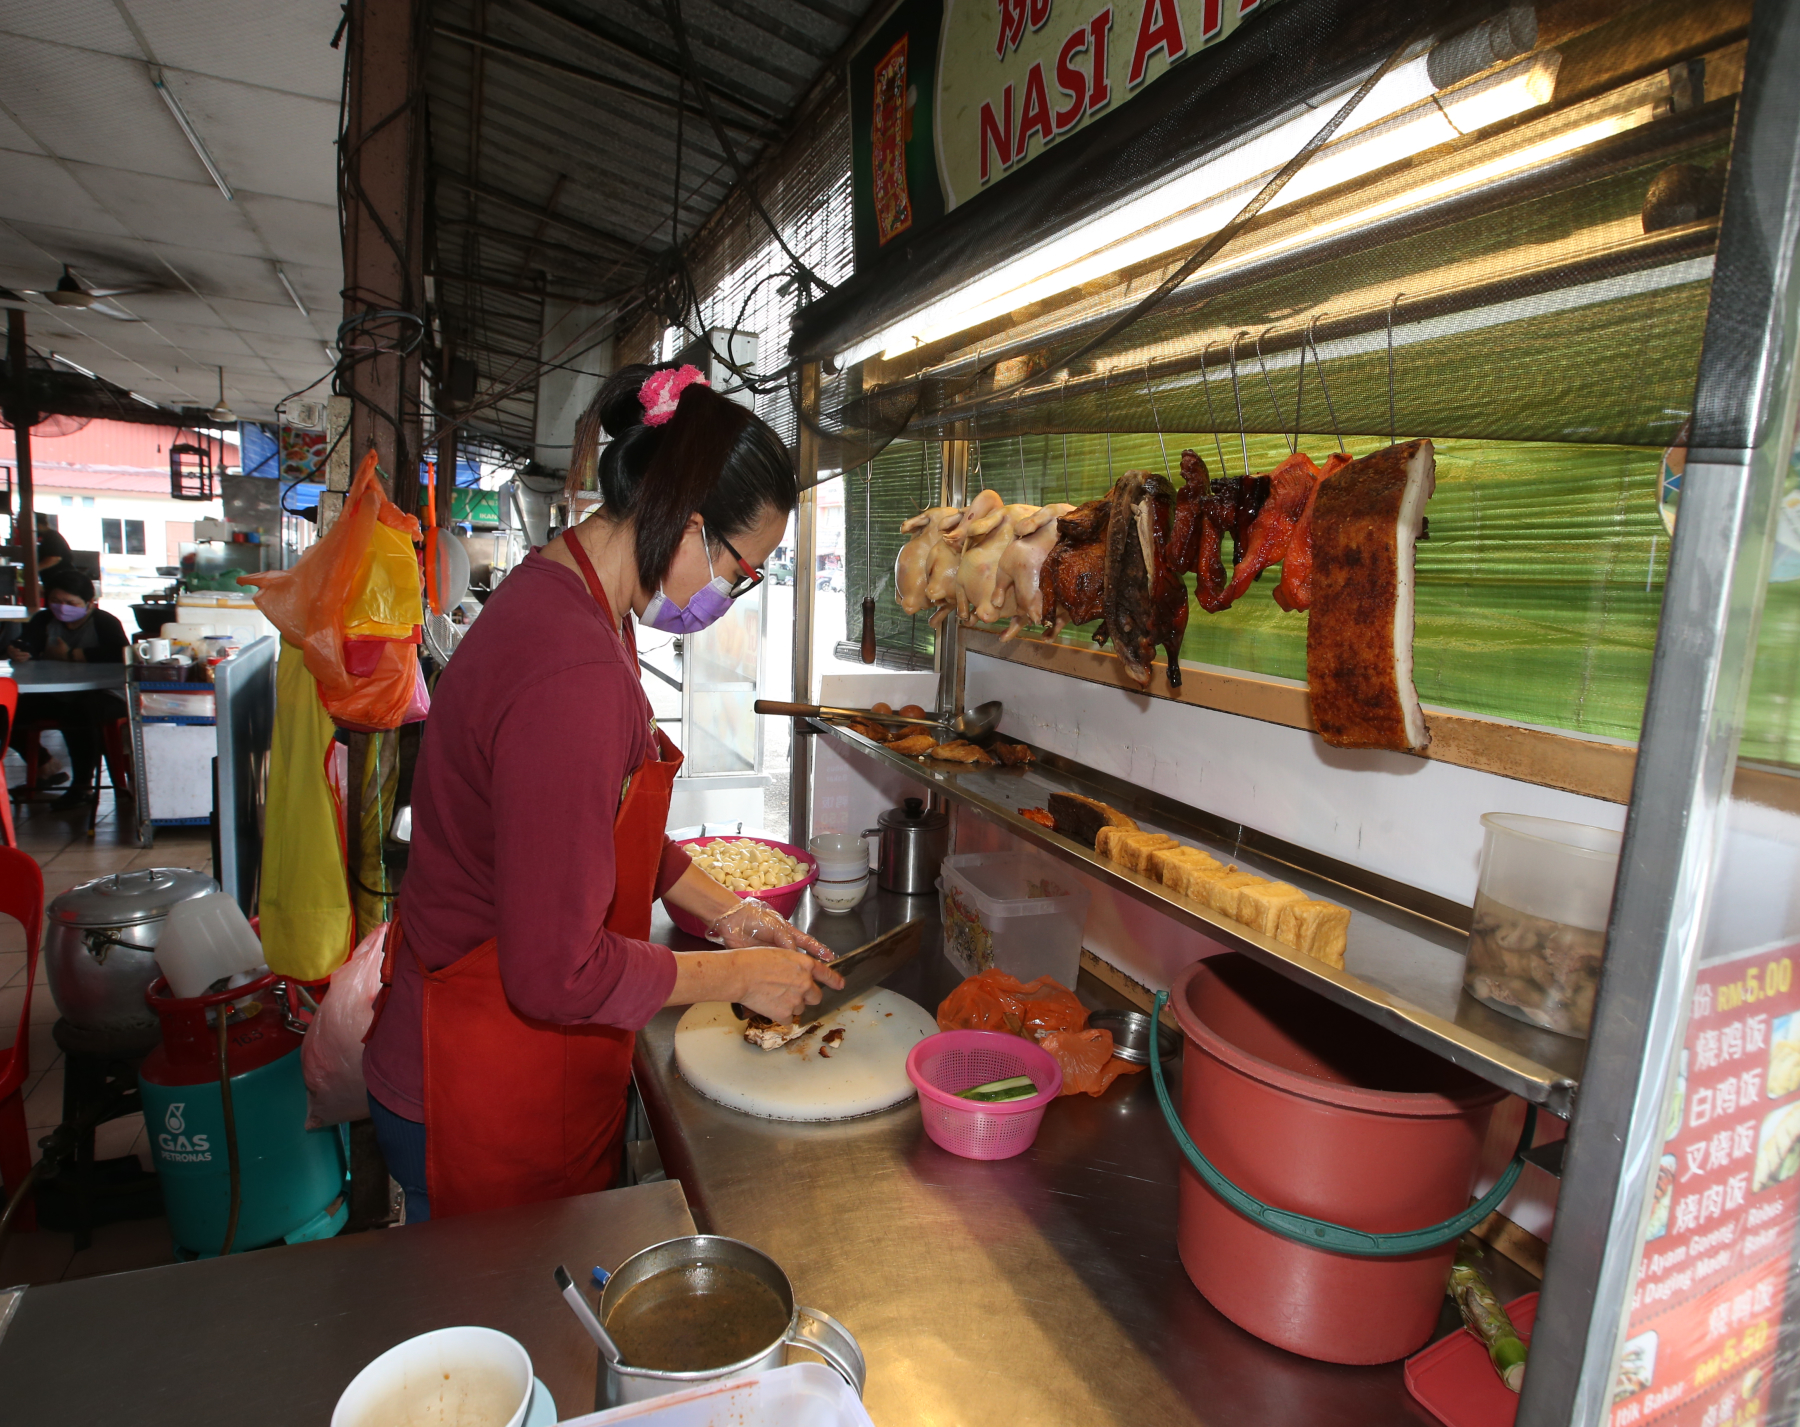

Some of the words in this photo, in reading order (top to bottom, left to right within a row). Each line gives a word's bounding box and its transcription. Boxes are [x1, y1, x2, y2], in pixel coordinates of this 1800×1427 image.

[980, 9, 1111, 184] NASI
[1694, 1013, 1768, 1072] 烧鸡饭
[1689, 1068, 1762, 1128] 白鸡饭
[158, 1133, 211, 1151] GAS
[160, 1151, 212, 1163] PETRONAS
[1680, 1120, 1757, 1183] 叉烧饭
[1672, 1171, 1749, 1236] 烧肉饭
[1648, 1245, 1687, 1276] Ayam
[1643, 1380, 1685, 1416] Bakar
